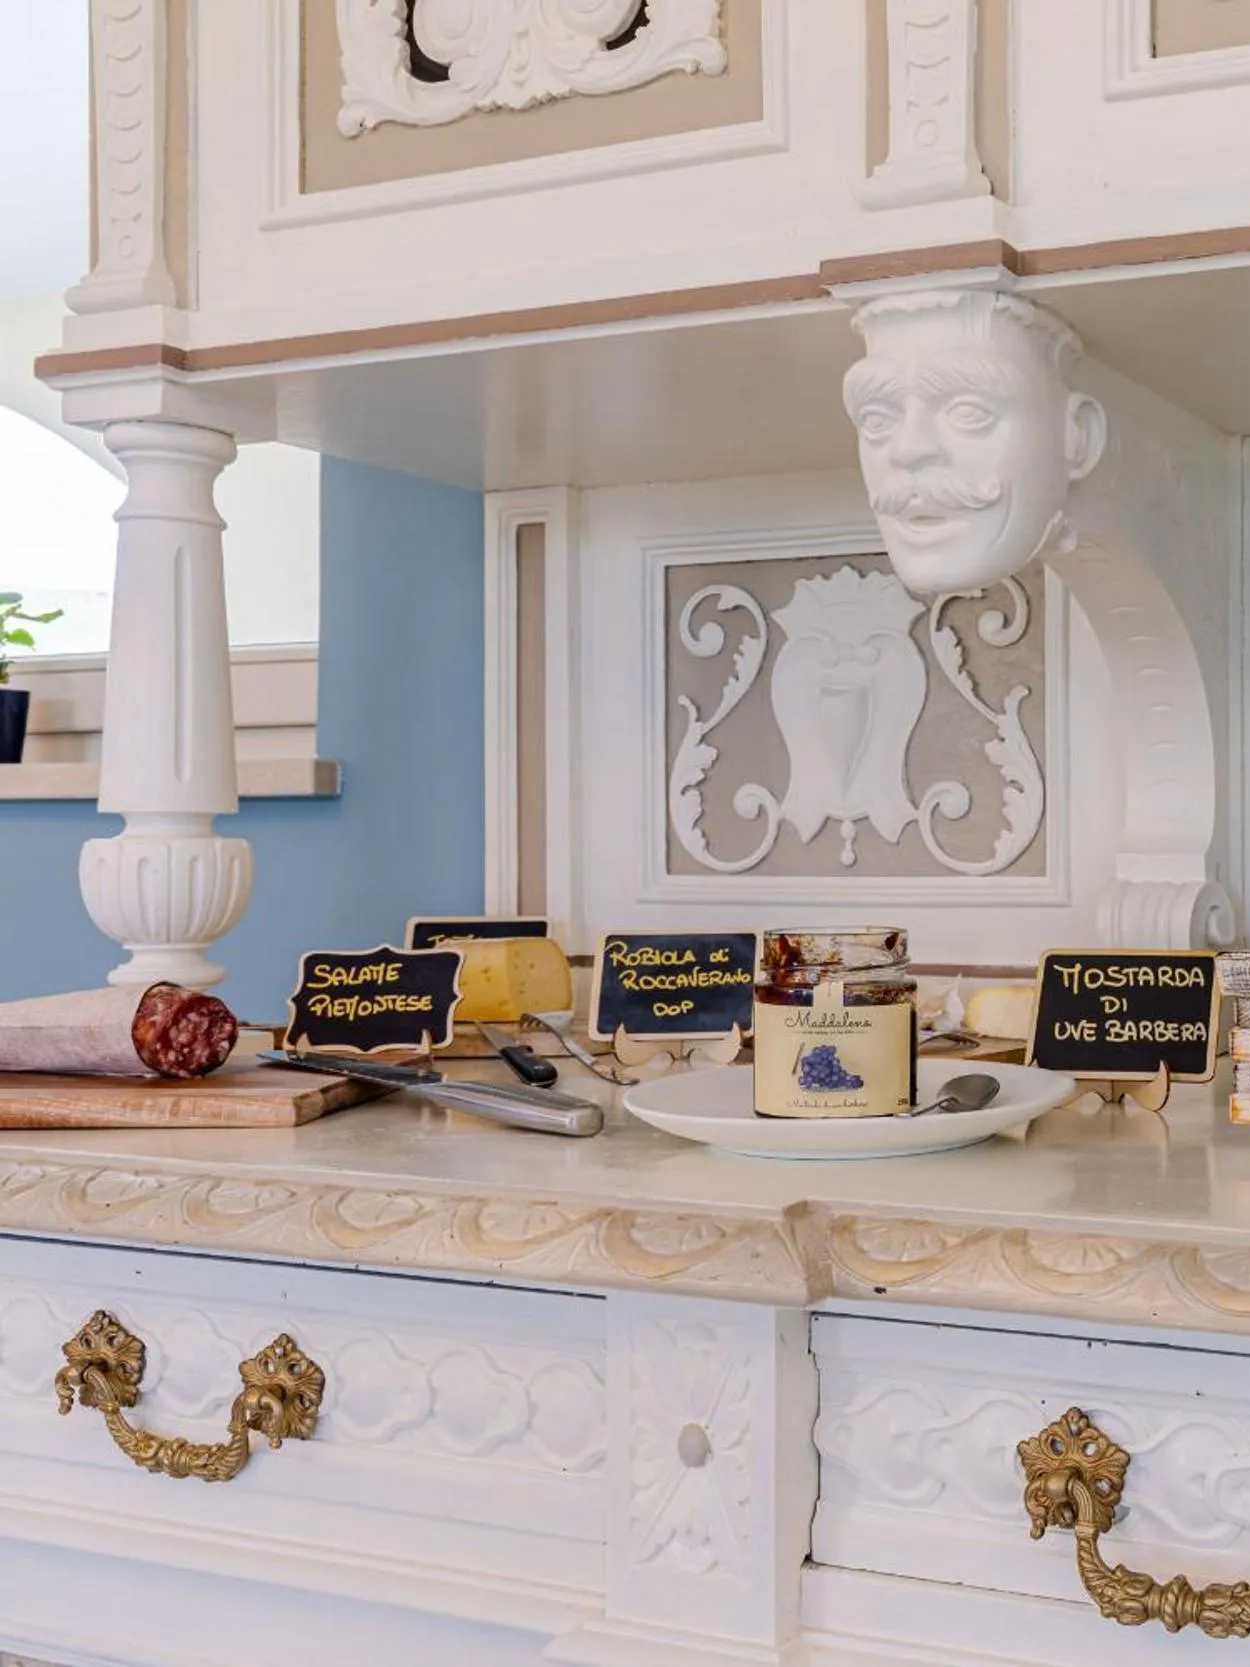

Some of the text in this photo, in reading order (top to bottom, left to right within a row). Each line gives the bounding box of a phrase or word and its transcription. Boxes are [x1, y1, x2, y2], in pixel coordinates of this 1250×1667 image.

[604, 941, 696, 967] ROBIOLA
[307, 963, 402, 988] SALAME
[619, 967, 751, 991] ROCCAVERANO
[1053, 962, 1205, 995] MOSTARDA
[308, 994, 433, 1022] PIEMONTESE
[1100, 995, 1128, 1014] DI
[784, 1009, 872, 1028] Maddalena
[1054, 1019, 1208, 1042] UVE BARBERA
